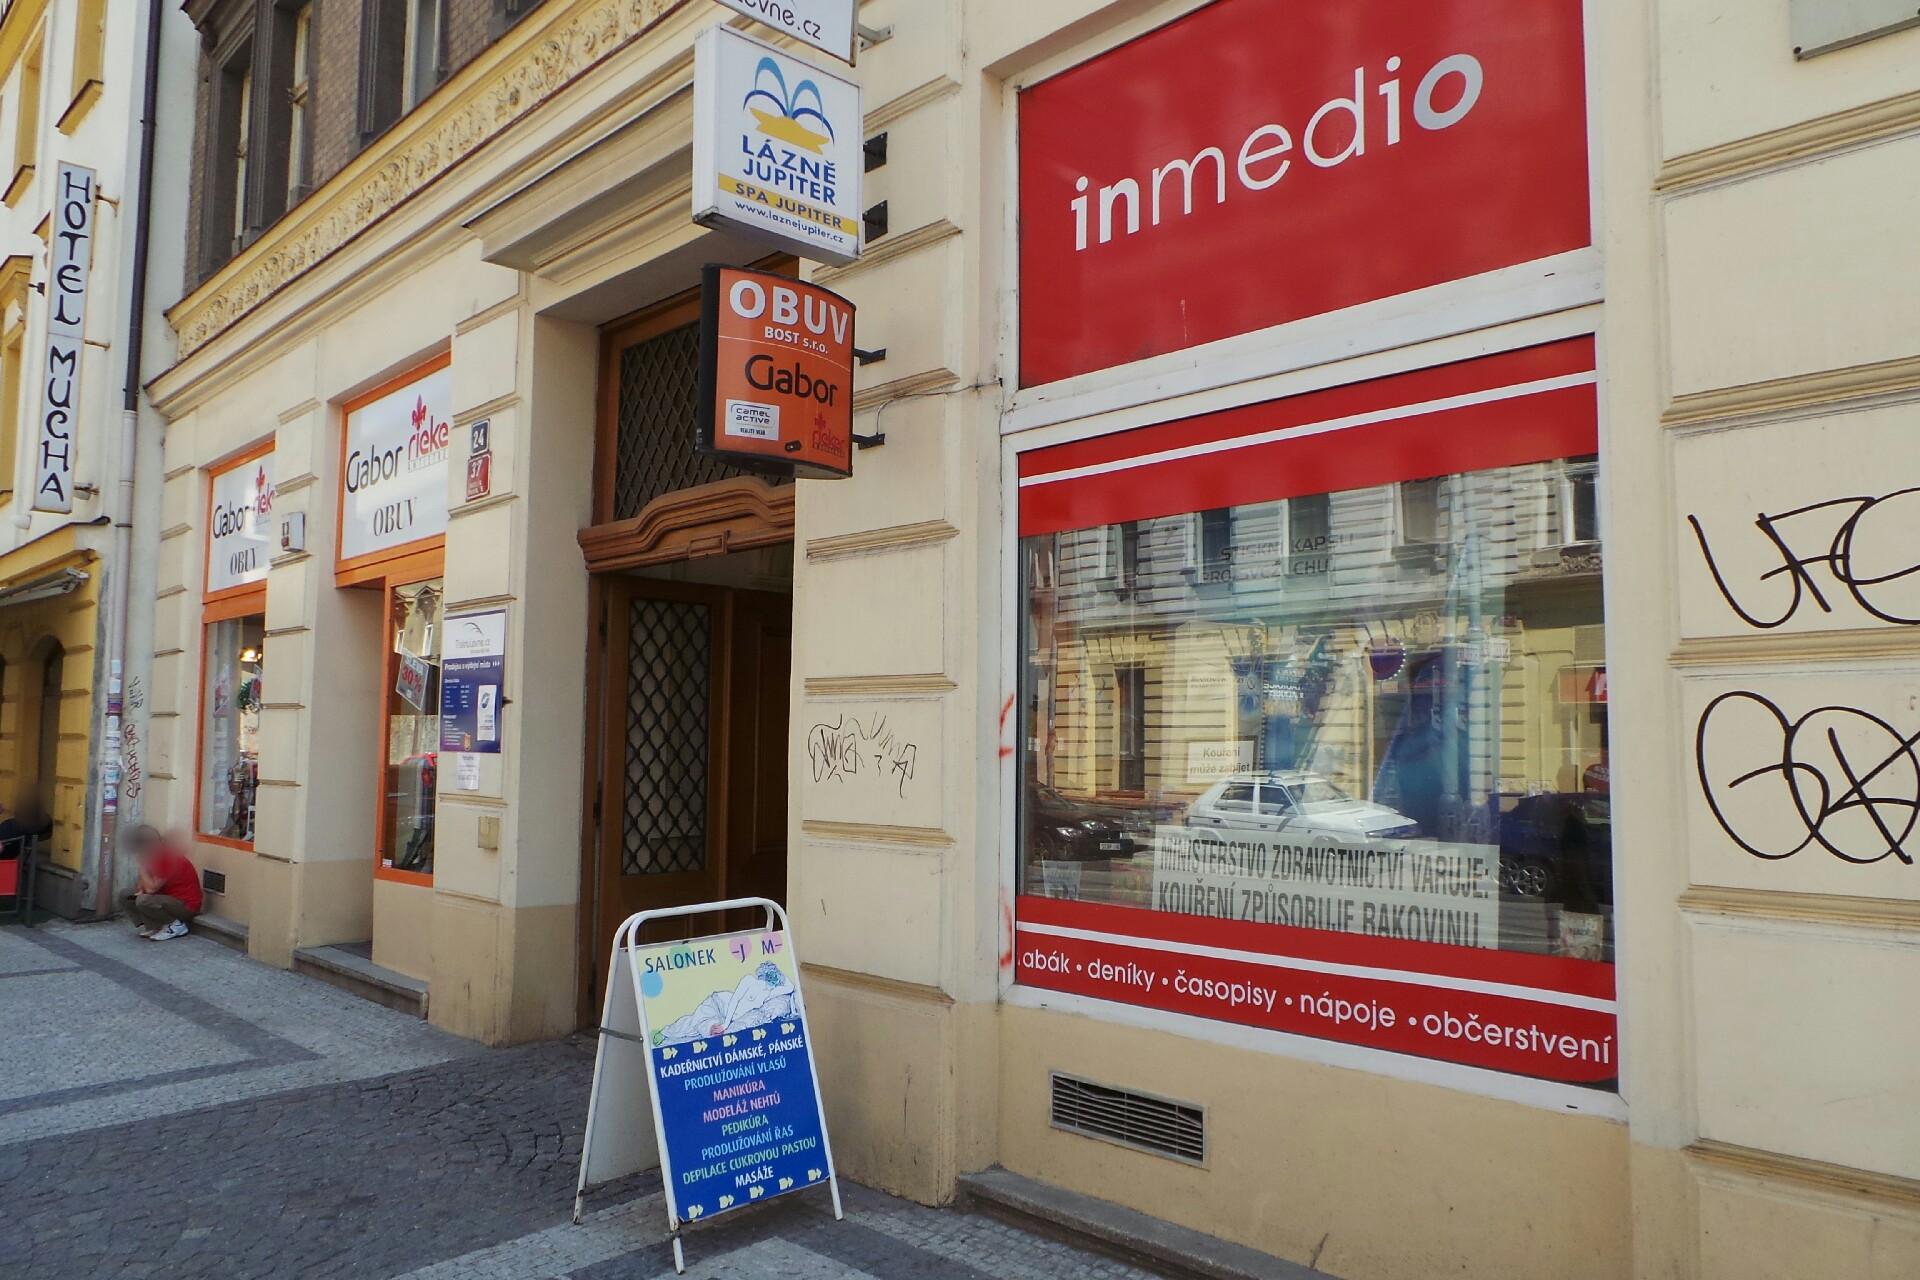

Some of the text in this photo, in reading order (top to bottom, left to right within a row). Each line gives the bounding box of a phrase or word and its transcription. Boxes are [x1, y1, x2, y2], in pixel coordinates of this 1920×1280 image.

[742, 134, 836, 185] LÁZNĚ
[1071, 53, 1484, 252] inmedio
[743, 158, 836, 206] JUPITER
[735, 182, 842, 229] SPA JUPITER
[735, 201, 844, 243] www.laznejupiter.cz
[729, 279, 848, 345] OBUV
[40, 171, 91, 502] HOTEL MUCHA
[764, 325, 829, 354] BOST s.r.o.
[744, 354, 839, 407] Gabor
[473, 428, 484, 449] 24
[346, 444, 404, 493] Gabor
[470, 459, 483, 479] 37
[213, 500, 250, 539] Gabor
[373, 496, 418, 537] OBUV
[1161, 837, 1489, 899] MINISTERSTVO ZDRAVOTNICTVÍ VARUJE:
[1159, 878, 1486, 949] KOUŘENÍ ZPŮSOBUJE RAKOVINU.
[645, 948, 717, 974] SALONEK
[1018, 948, 1613, 1064] abák deníky časopisy nápoje občerstvení
[660, 1034, 804, 1079] KADEŘNICTVÍ DÁMSKÉ, PÁNSKÉ
[684, 1055, 787, 1091] PRODLUŽOVÁNÍ VLASŮ
[703, 1090, 781, 1124] MODELÁŽ NEHTŮ
[713, 1079, 766, 1102] MANIKÚRA
[701, 1124, 794, 1161] PRODLUŽOVÁNÍ ŘAS
[721, 1114, 769, 1137] PEDIKÚRA
[682, 1136, 817, 1185] DEPILACE CUKROVOU PASTOU
[735, 1166, 775, 1188] MASÁŽE
